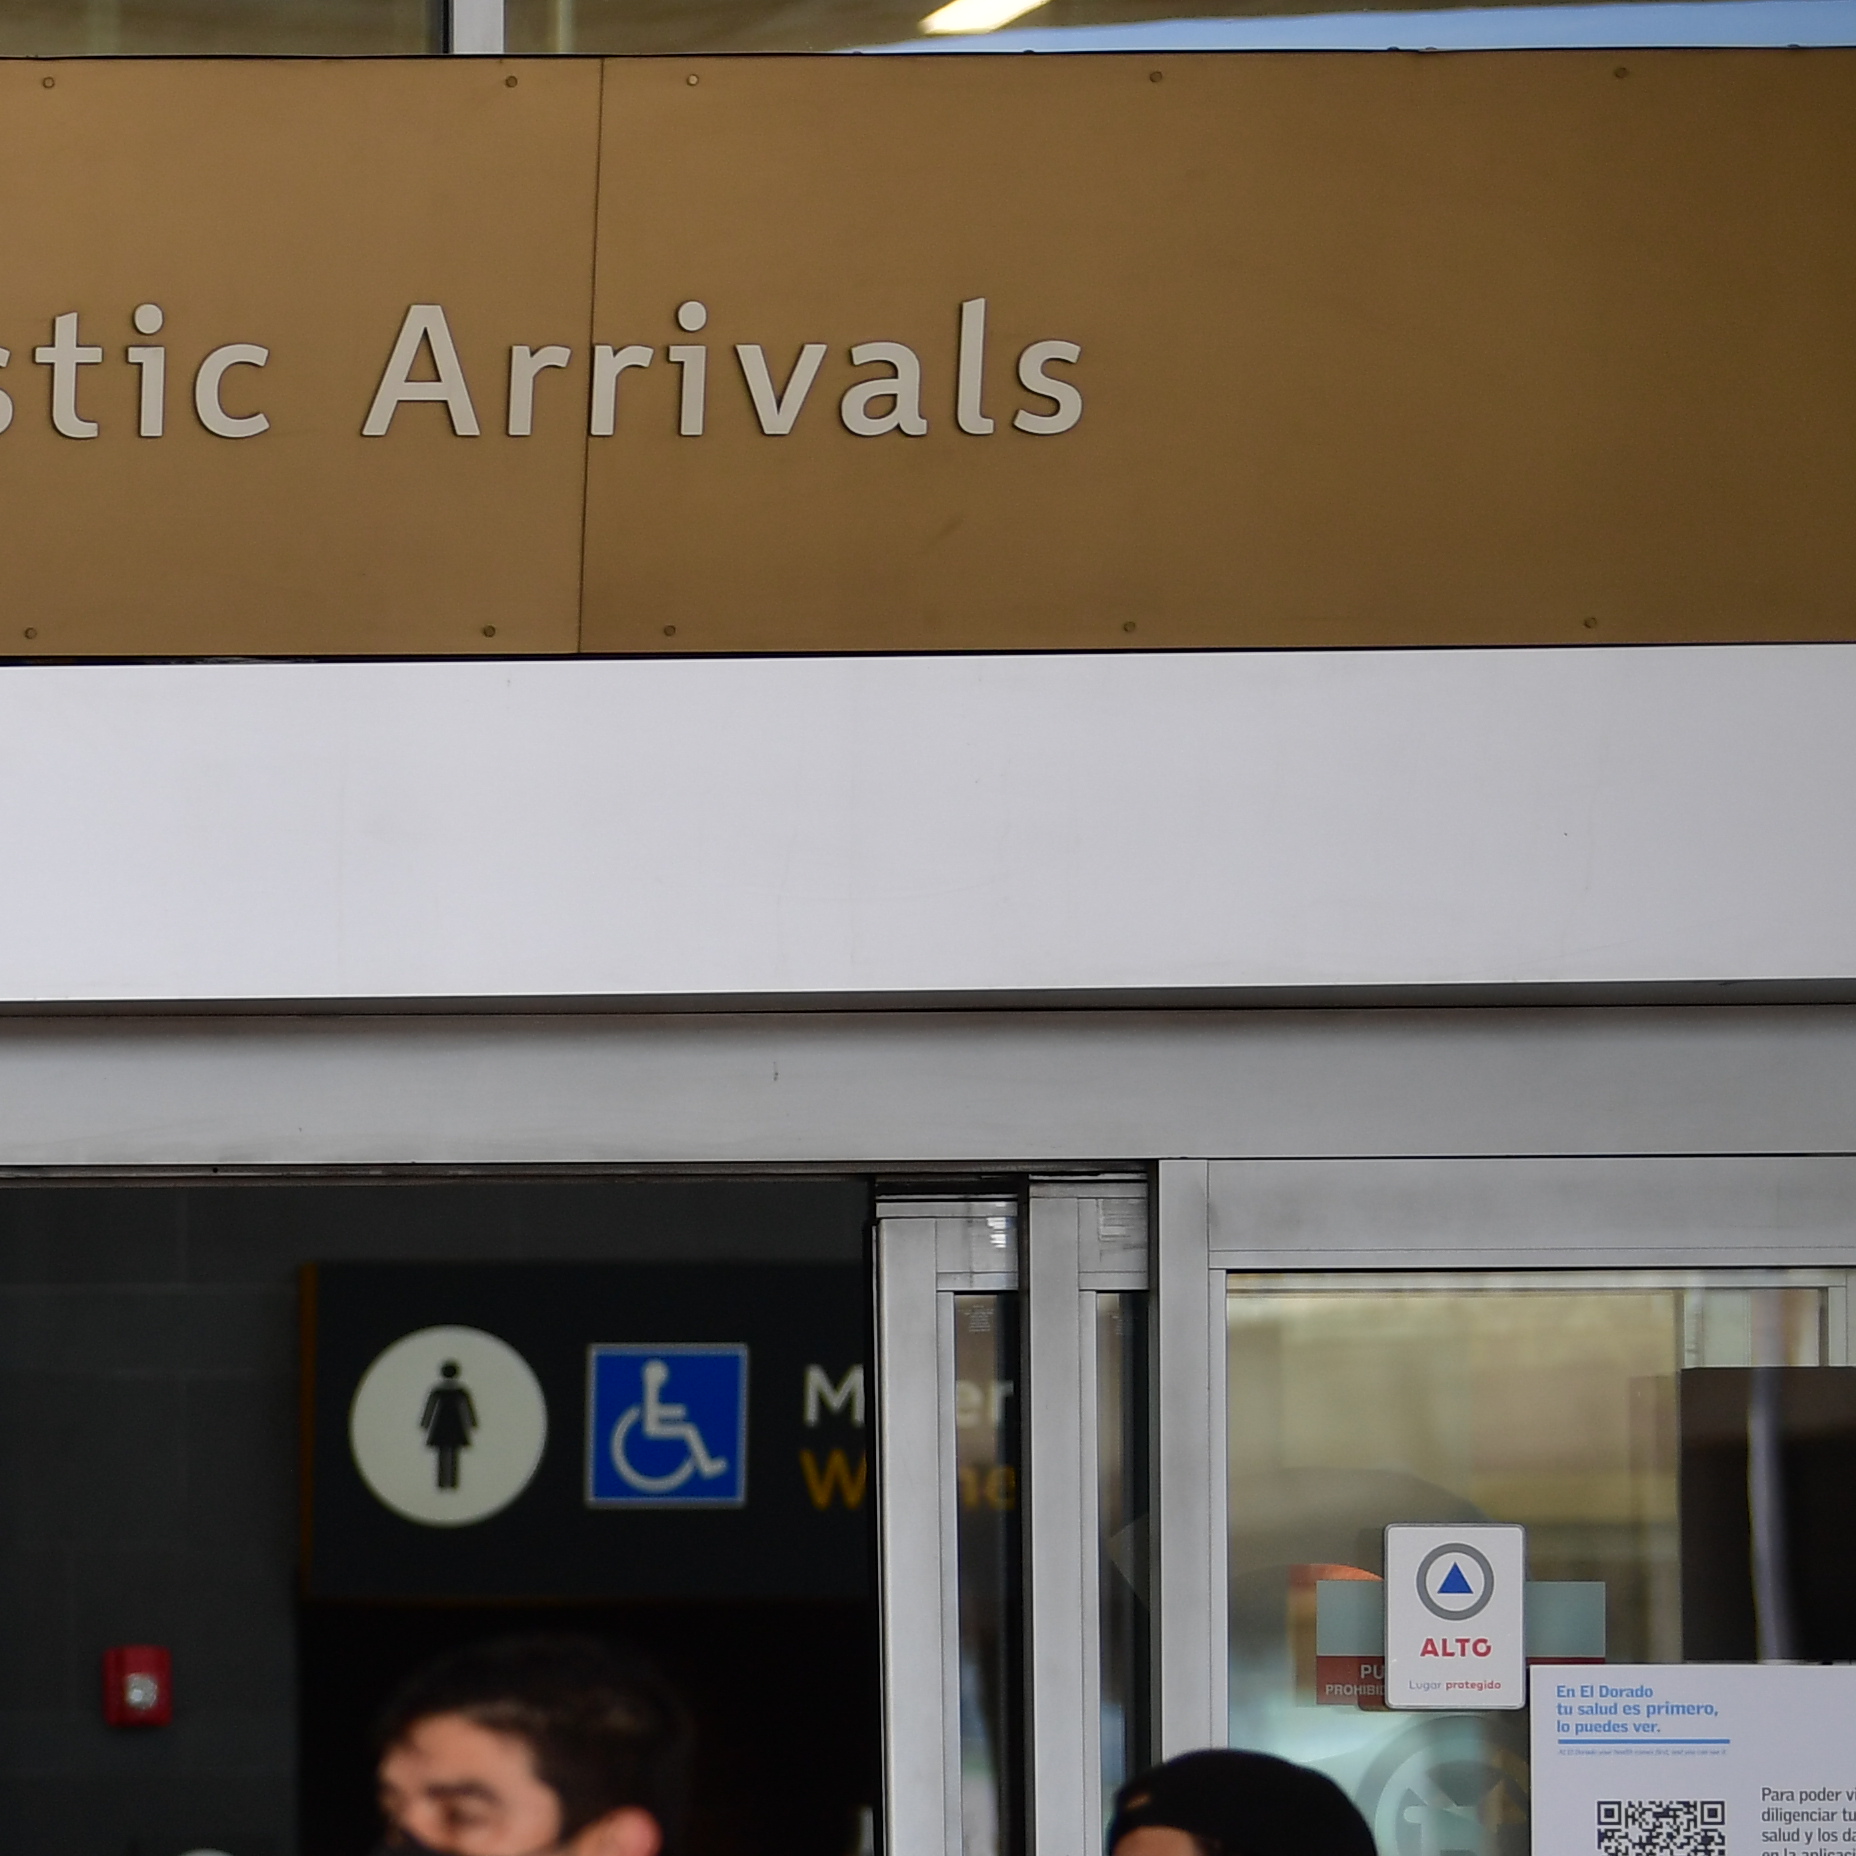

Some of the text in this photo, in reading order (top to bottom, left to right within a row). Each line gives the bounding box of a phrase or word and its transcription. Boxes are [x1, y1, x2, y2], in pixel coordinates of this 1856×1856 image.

[362, 296, 1084, 438] Arrivals
[1419, 1638, 1493, 1658] ALTO
[1408, 1680, 1501, 1691] Lugar protegido
[1557, 1686, 1654, 1698] En El Dorado
[1557, 1702, 1719, 1718] tu salud es primero,
[1557, 1720, 1661, 1736] lo puedes ver.
[1761, 1787, 1795, 1802] Para
[1799, 1787, 1843, 1805] poder
[1761, 1808, 1839, 1824] diligenciar
[1761, 1828, 1801, 1843] salud
[1804, 1832, 1814, 1846] y
[1817, 1828, 1839, 1843] los
